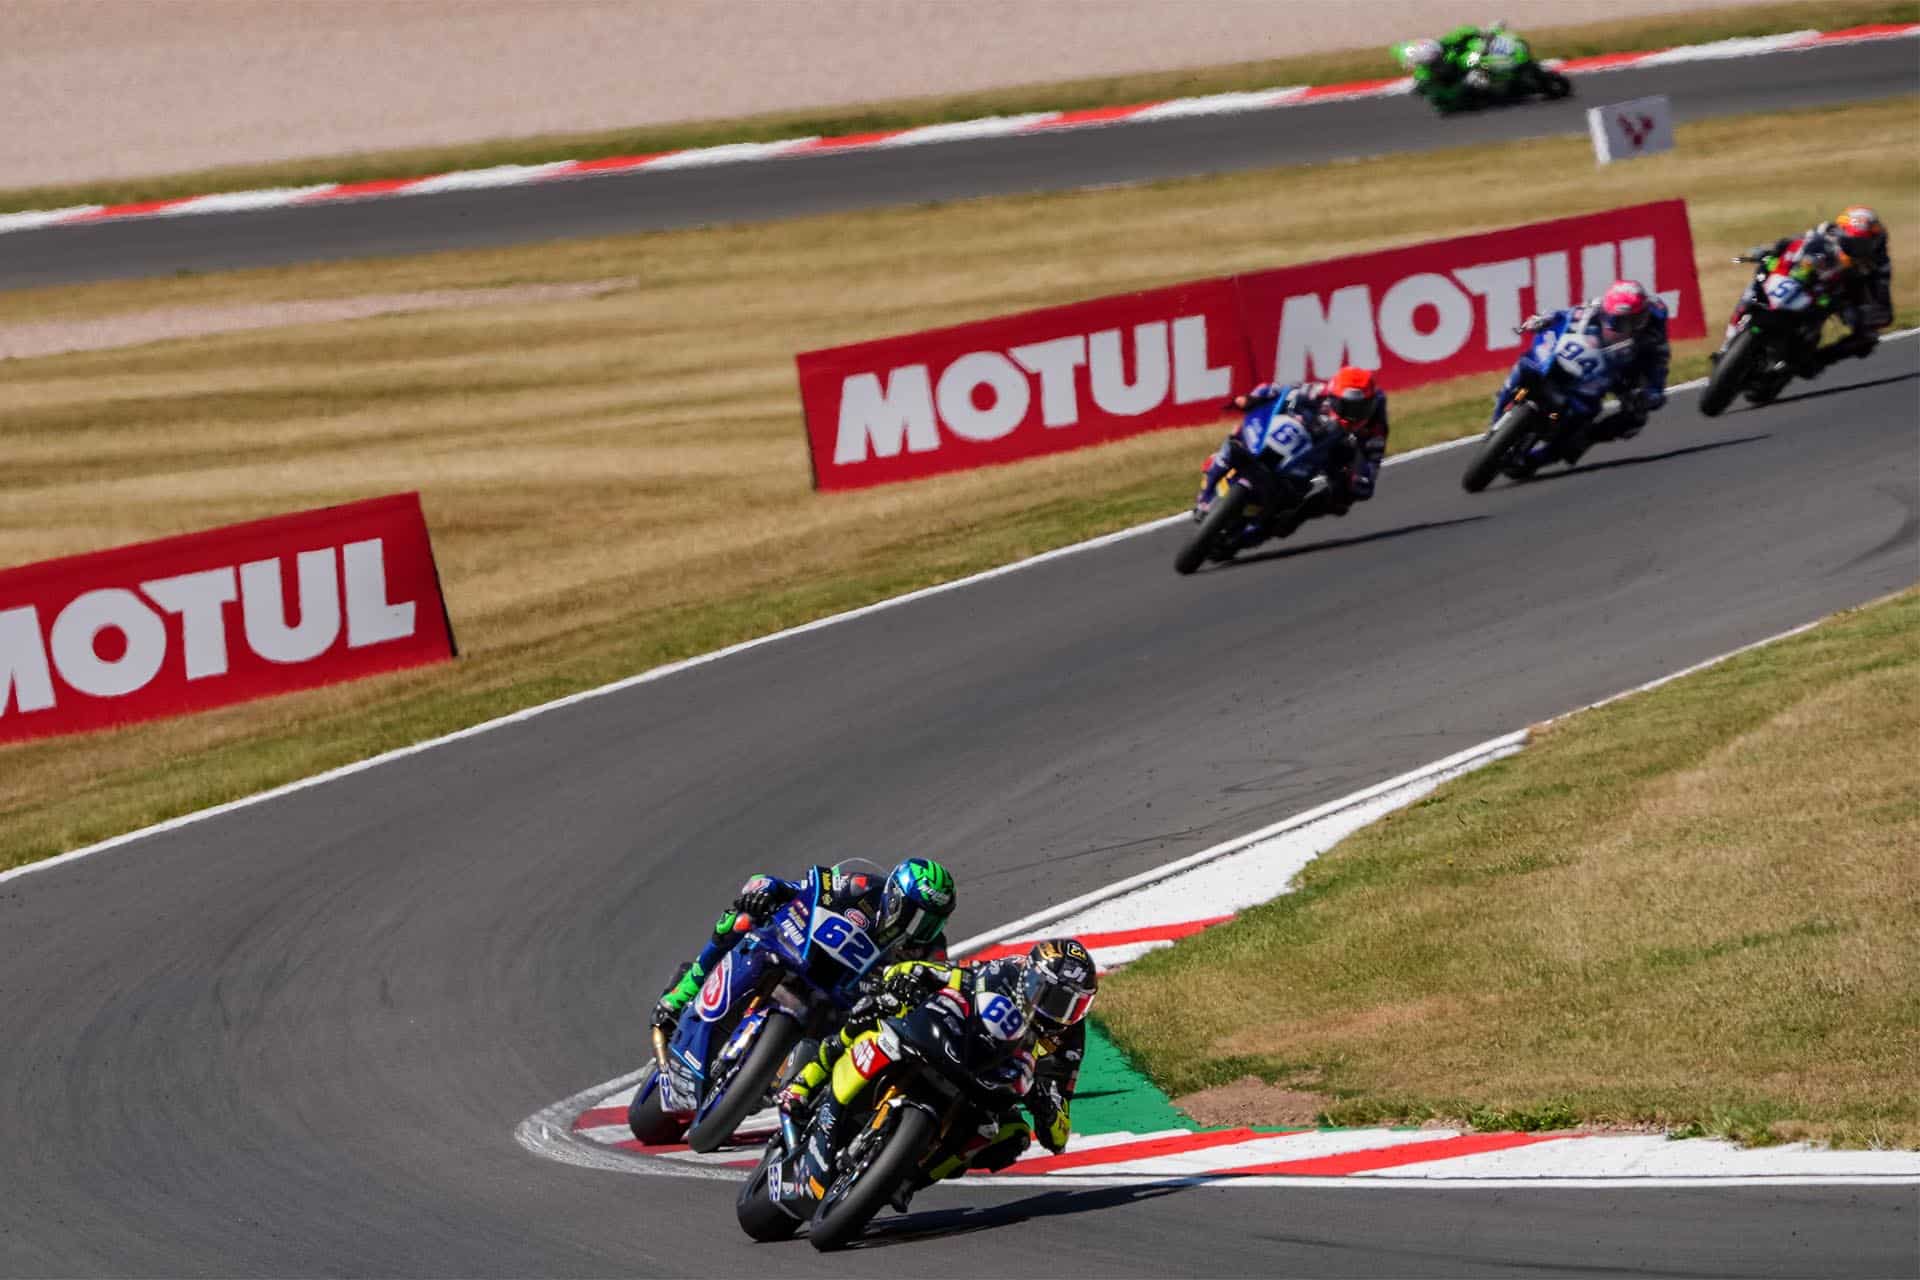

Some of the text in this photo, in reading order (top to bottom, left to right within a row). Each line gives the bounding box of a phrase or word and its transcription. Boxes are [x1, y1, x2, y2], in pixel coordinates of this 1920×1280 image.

[1274, 236, 1681, 386] MOTUL
[833, 314, 1233, 466] MOTUL
[813, 915, 875, 971] 62
[981, 995, 1024, 1038] 69
